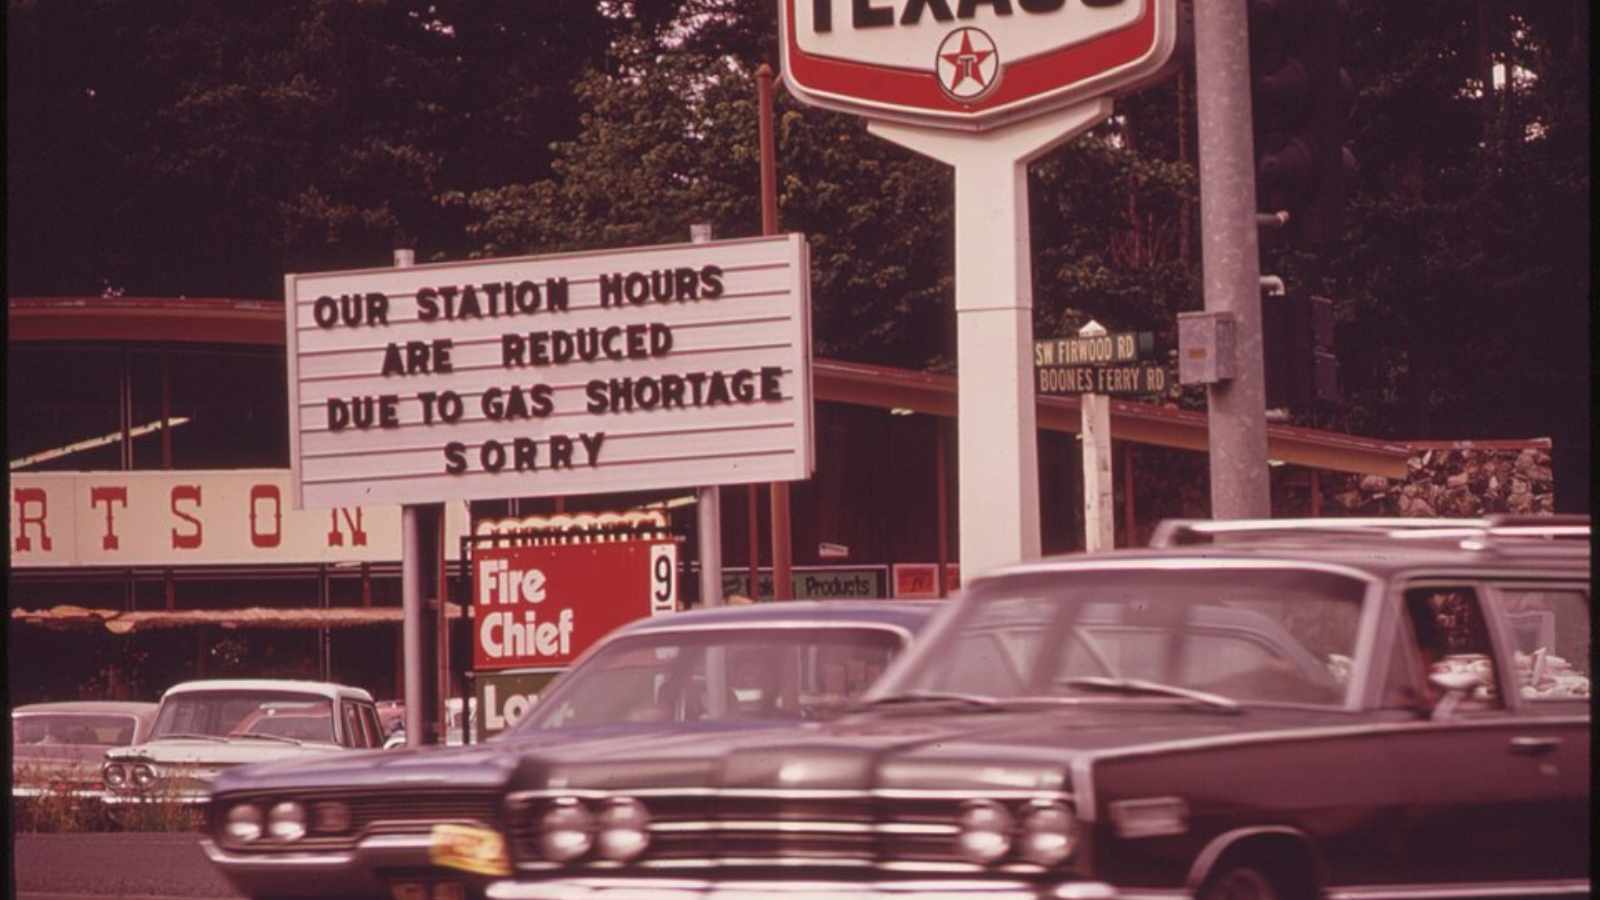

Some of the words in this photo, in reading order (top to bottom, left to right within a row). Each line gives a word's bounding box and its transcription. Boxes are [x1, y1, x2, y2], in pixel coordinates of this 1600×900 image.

[313, 292, 389, 329] OUR
[416, 278, 567, 322] STATION
[600, 265, 724, 308] HOURS
[382, 339, 453, 376] ARE
[502, 323, 674, 368] REDUCED
[1035, 342, 1054, 366] SW
[1058, 338, 1112, 363] FIRWOOD
[1117, 335, 1135, 359] RD
[327, 395, 398, 431] DUE
[418, 391, 463, 425] TO
[481, 384, 553, 421] GAS
[586, 367, 783, 414] SHORTAGE
[1040, 368, 1093, 391] BOONES
[1098, 367, 1139, 391] FERRY
[1146, 368, 1165, 391] RD
[444, 433, 604, 475] SORRY
[479, 559, 546, 605] Fire
[655, 555, 672, 602] 9
[805, 575, 870, 594] Products
[480, 608, 574, 658] Chief
[484, 684, 539, 730] Lo
